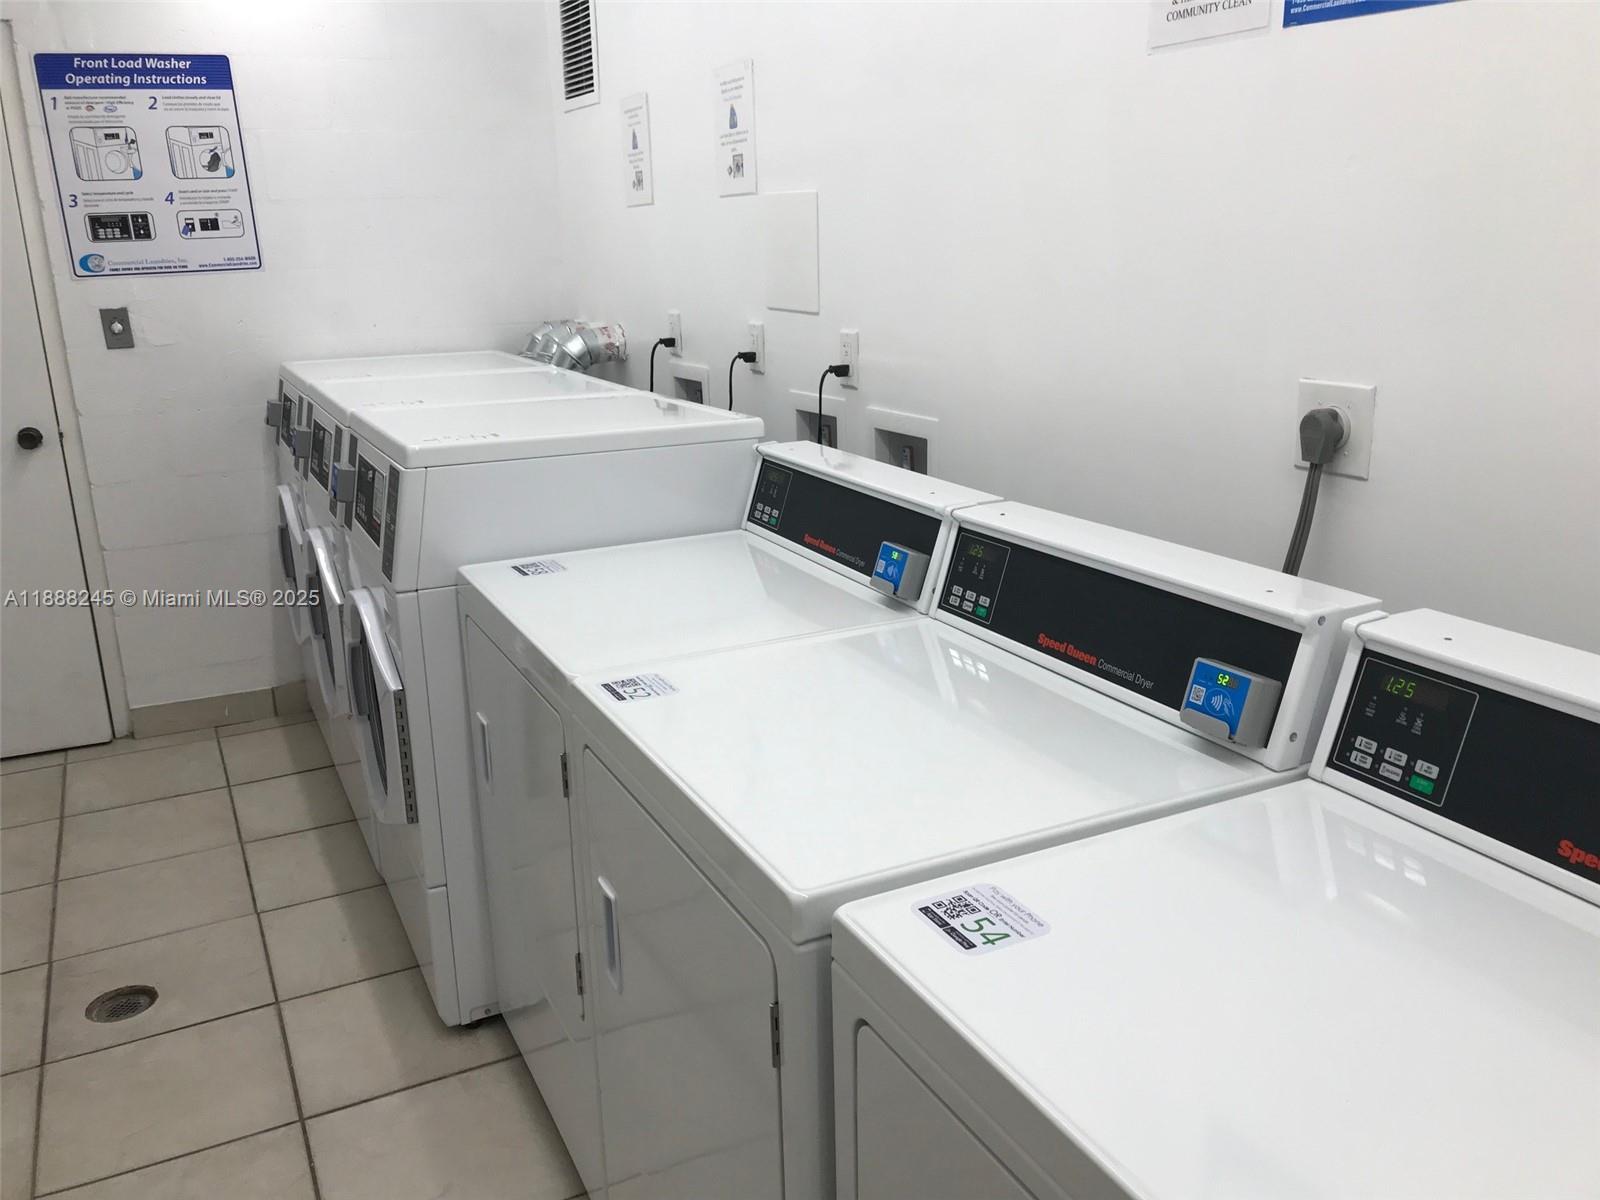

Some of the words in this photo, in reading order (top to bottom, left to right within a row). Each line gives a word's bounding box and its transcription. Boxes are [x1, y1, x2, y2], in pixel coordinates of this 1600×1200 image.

[1166, 2, 1220, 22] COMMUNITY
[1222, 0, 1252, 10] CLEAN
[74, 58, 108, 68] Front
[111, 58, 142, 68] Load
[145, 58, 192, 69] Washer
[65, 73, 130, 86] Operating
[134, 74, 207, 84] Instructions
[50, 96, 58, 110] 1
[148, 96, 158, 110] 2
[68, 194, 78, 207] 3
[164, 192, 175, 205] 4
[1038, 633, 1066, 653] Speed
[1066, 644, 1097, 666] Queen
[1098, 658, 1134, 681] Commercial
[1135, 674, 1154, 689] Dryer
[1217, 673, 1230, 686] 52
[623, 687, 651, 700] 52
[1556, 840, 1600, 870] Spe
[960, 916, 1011, 946] 54
